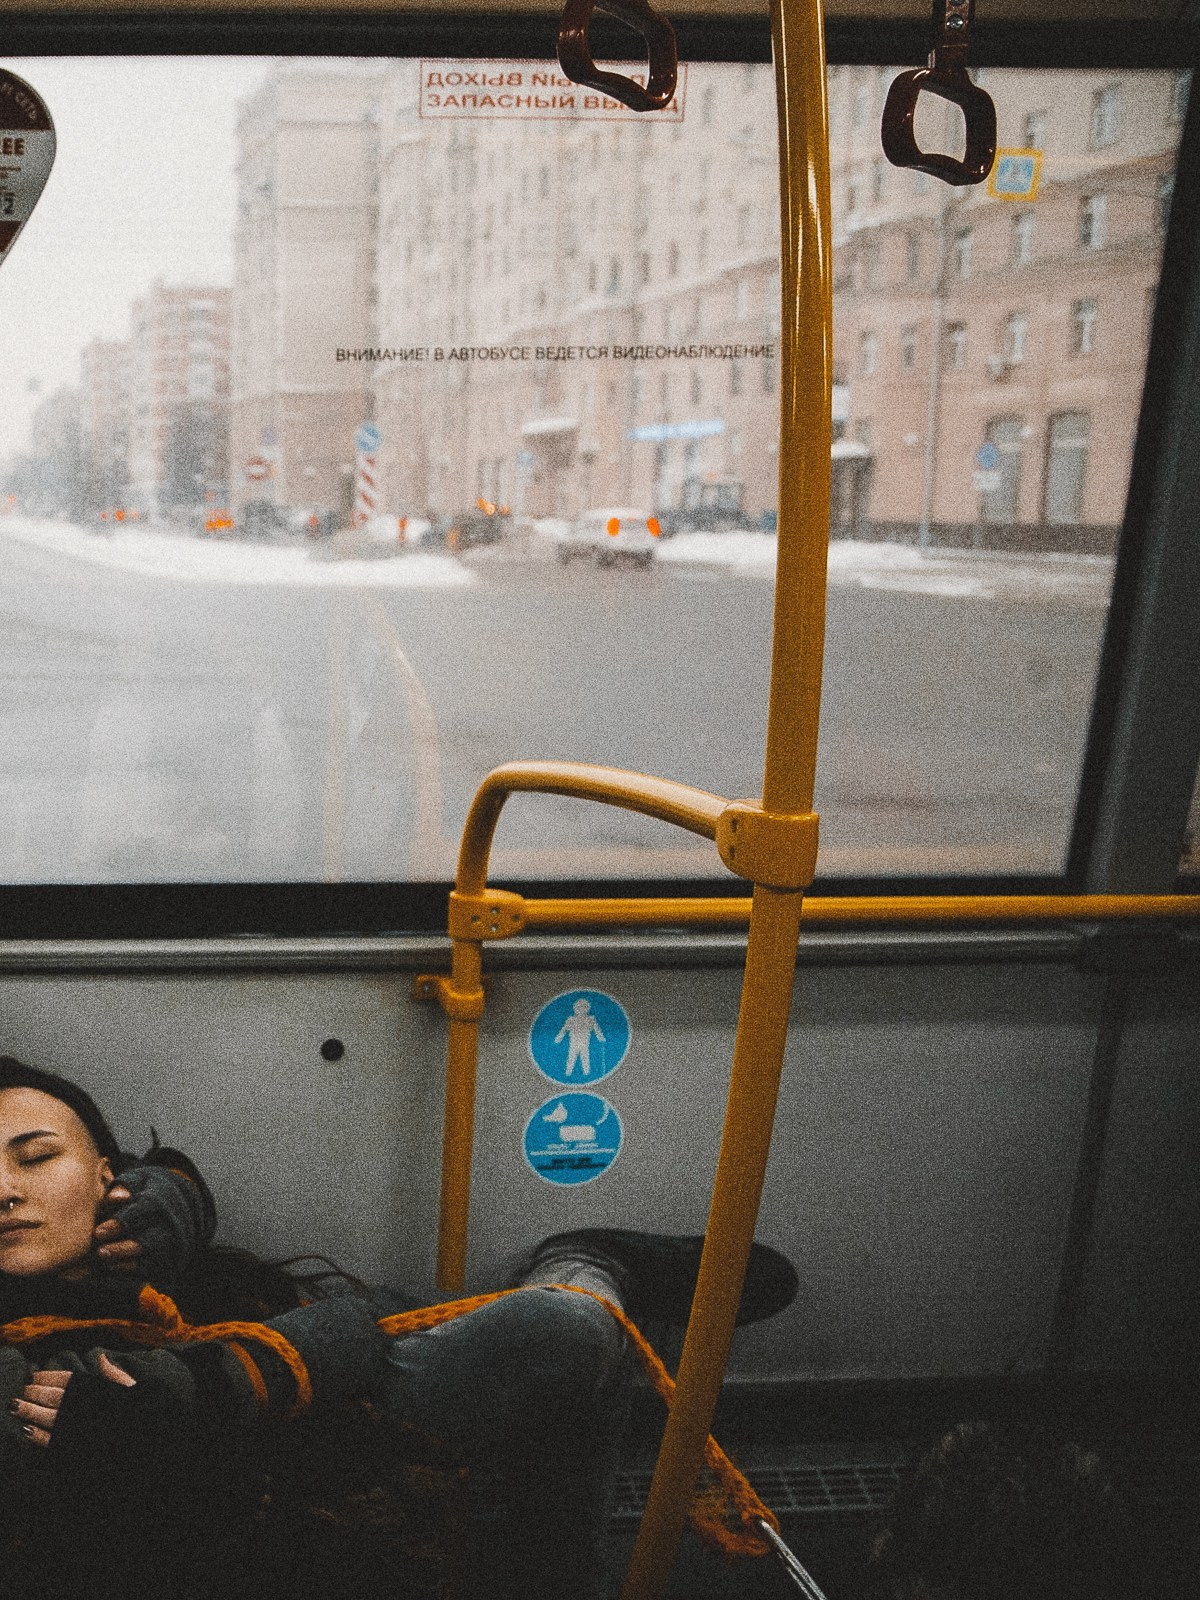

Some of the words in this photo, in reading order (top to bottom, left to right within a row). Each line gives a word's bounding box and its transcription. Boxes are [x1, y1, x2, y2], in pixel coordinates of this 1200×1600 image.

[427, 92, 575, 110] ЗАПАСНЫЙ
[584, 95, 678, 113] ВЫД
[336, 347, 430, 362] ВНИМАНИЕ!
[433, 346, 444, 362] В
[448, 345, 531, 362] АВТОБУСЕ
[535, 345, 609, 362] ВЕДЕТСЯ
[612, 343, 775, 361] ВИДЕОНАБЛЮДЕНИЕ
